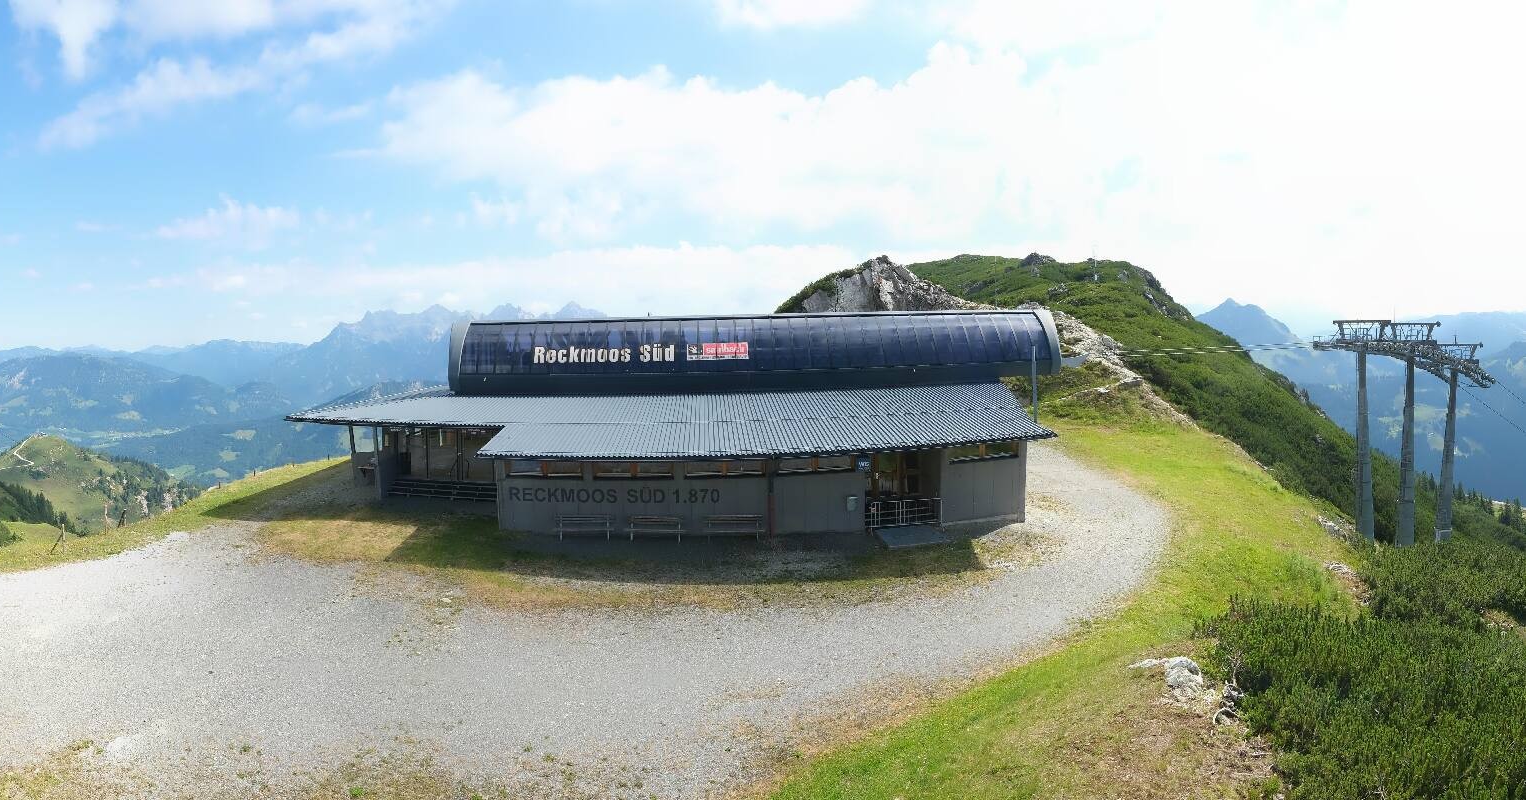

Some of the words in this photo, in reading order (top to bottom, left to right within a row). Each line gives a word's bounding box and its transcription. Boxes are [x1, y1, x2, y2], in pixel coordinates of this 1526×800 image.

[533, 346, 631, 364] Reckmoos
[640, 344, 675, 362] Süd
[508, 486, 618, 504] RECKMOOS
[627, 486, 665, 504] SÜD
[673, 488, 720, 504] 1.870
